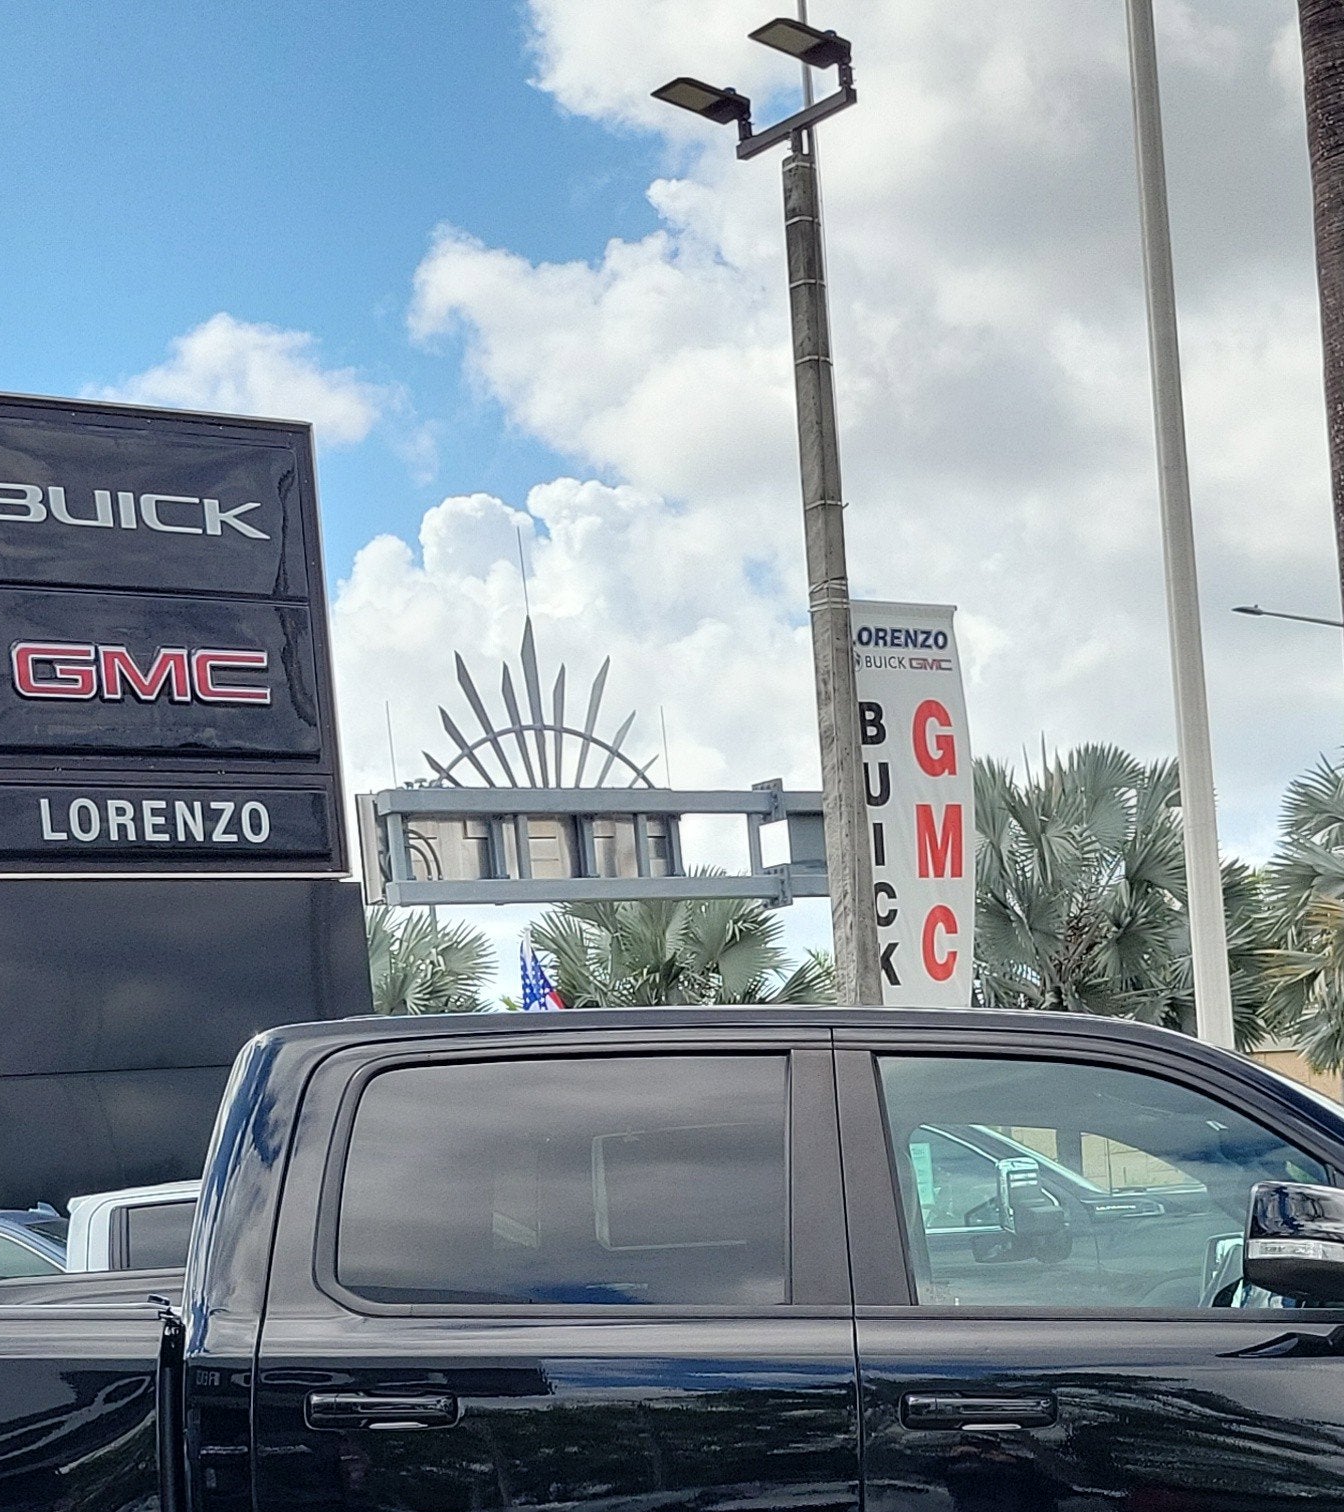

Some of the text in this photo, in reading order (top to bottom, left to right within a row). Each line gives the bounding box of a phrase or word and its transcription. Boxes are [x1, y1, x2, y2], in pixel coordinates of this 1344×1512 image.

[852, 626, 948, 652] ORENZO
[865, 655, 953, 671] BUICK GMC
[12, 639, 273, 705] GMC
[40, 796, 272, 844] LORENZO
[858, 700, 902, 987] BUICK
[911, 698, 964, 982] GMC
